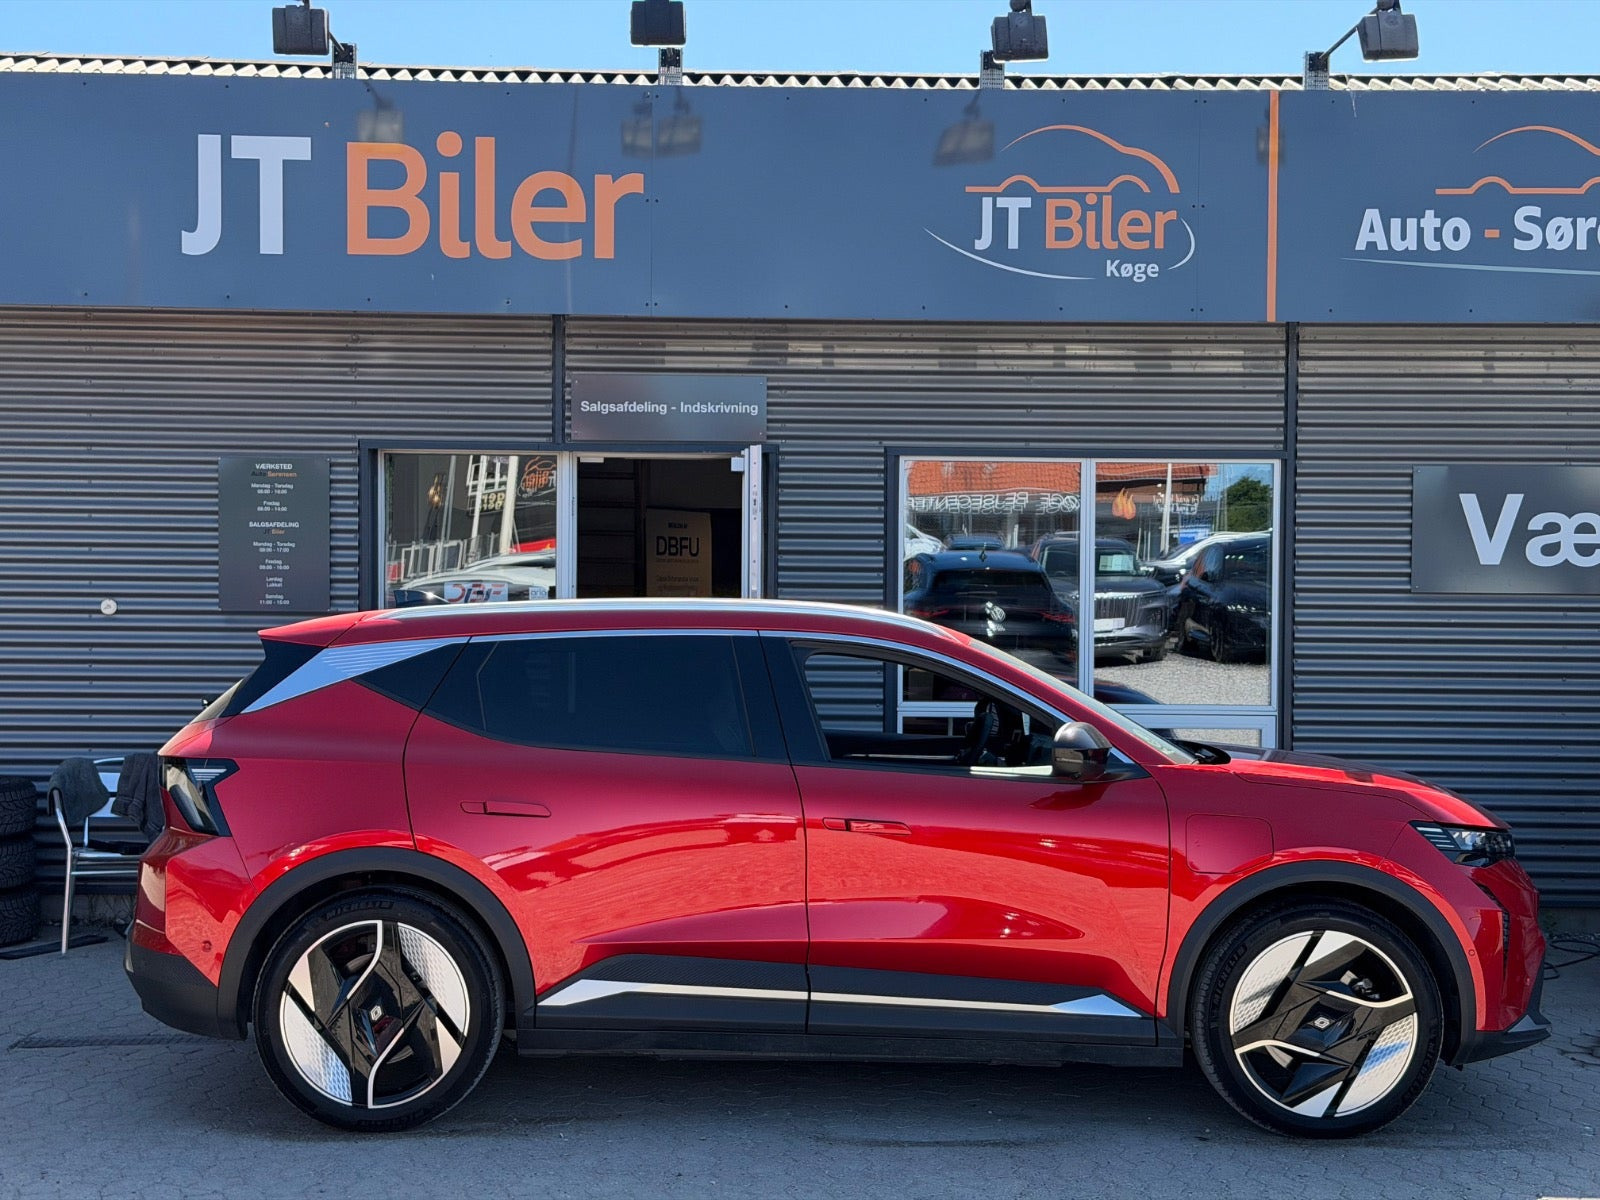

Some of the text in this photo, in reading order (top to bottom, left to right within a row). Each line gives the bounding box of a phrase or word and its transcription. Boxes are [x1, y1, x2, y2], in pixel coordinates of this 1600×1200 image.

[181, 130, 645, 260] JT Biler
[974, 192, 1177, 250] JT Biler
[1355, 208, 1471, 251] Auto
[1513, 205, 1600, 251] Sør
[1105, 259, 1159, 283] Køge
[580, 401, 668, 415] Salgsafdeling
[680, 401, 759, 416] Indskrivning
[656, 535, 699, 557] DBFU
[1210, 943, 1248, 1008] MICHELIN
